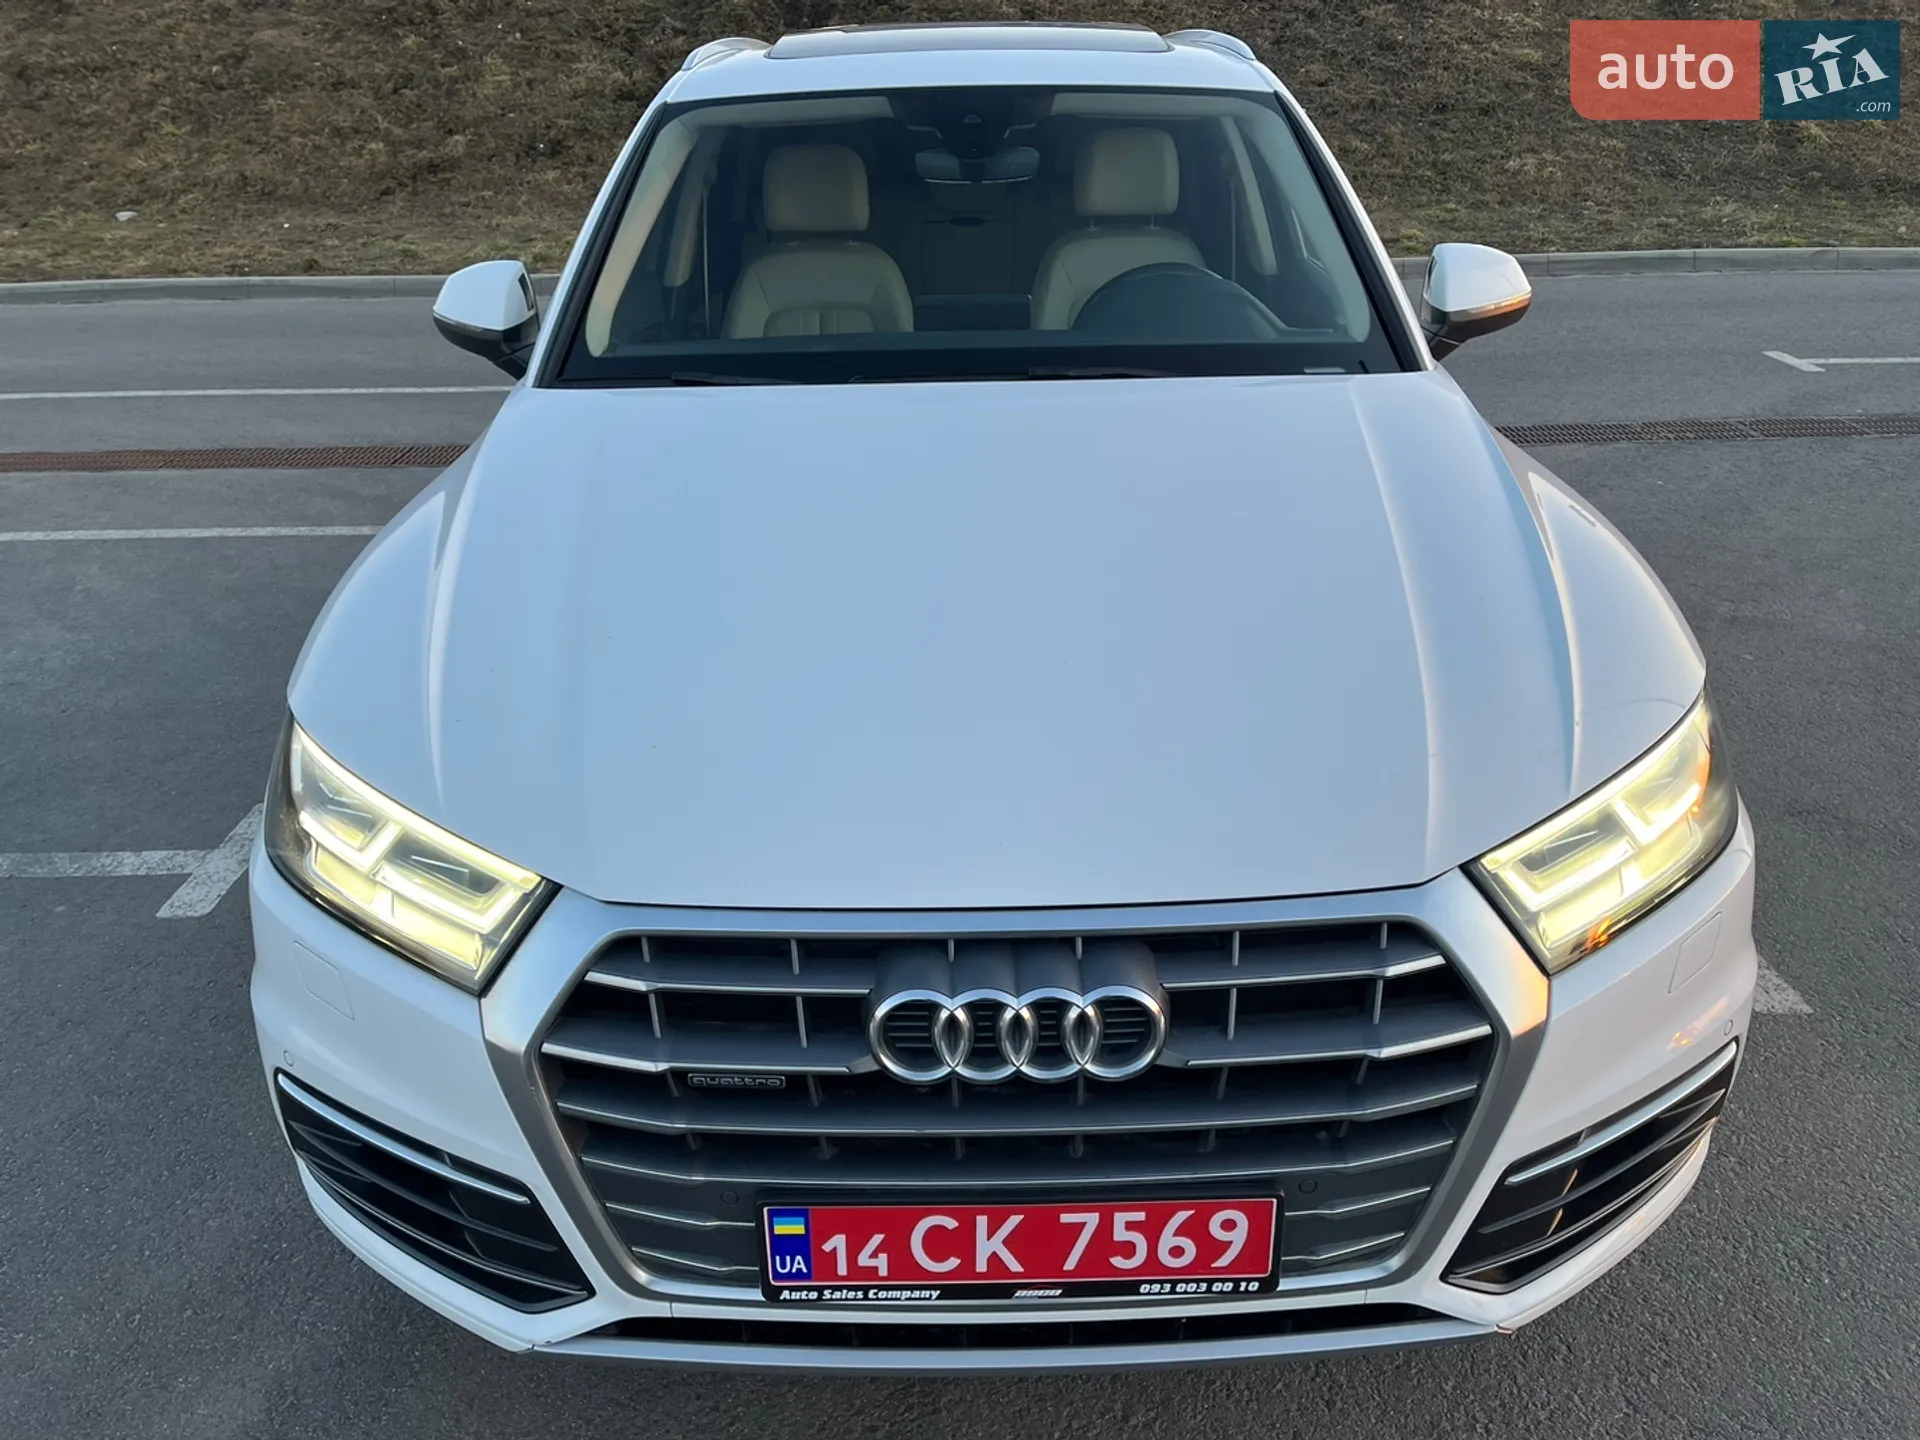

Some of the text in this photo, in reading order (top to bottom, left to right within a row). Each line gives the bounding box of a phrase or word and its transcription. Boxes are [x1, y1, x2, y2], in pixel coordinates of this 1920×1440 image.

[692, 1076, 780, 1087] quattro
[821, 1209, 1250, 1277] 14 CK 7569
[775, 1254, 808, 1274] UA
[1139, 1281, 1259, 1294] 093 003 00 10
[779, 1288, 941, 1301] Auto Sales Company
